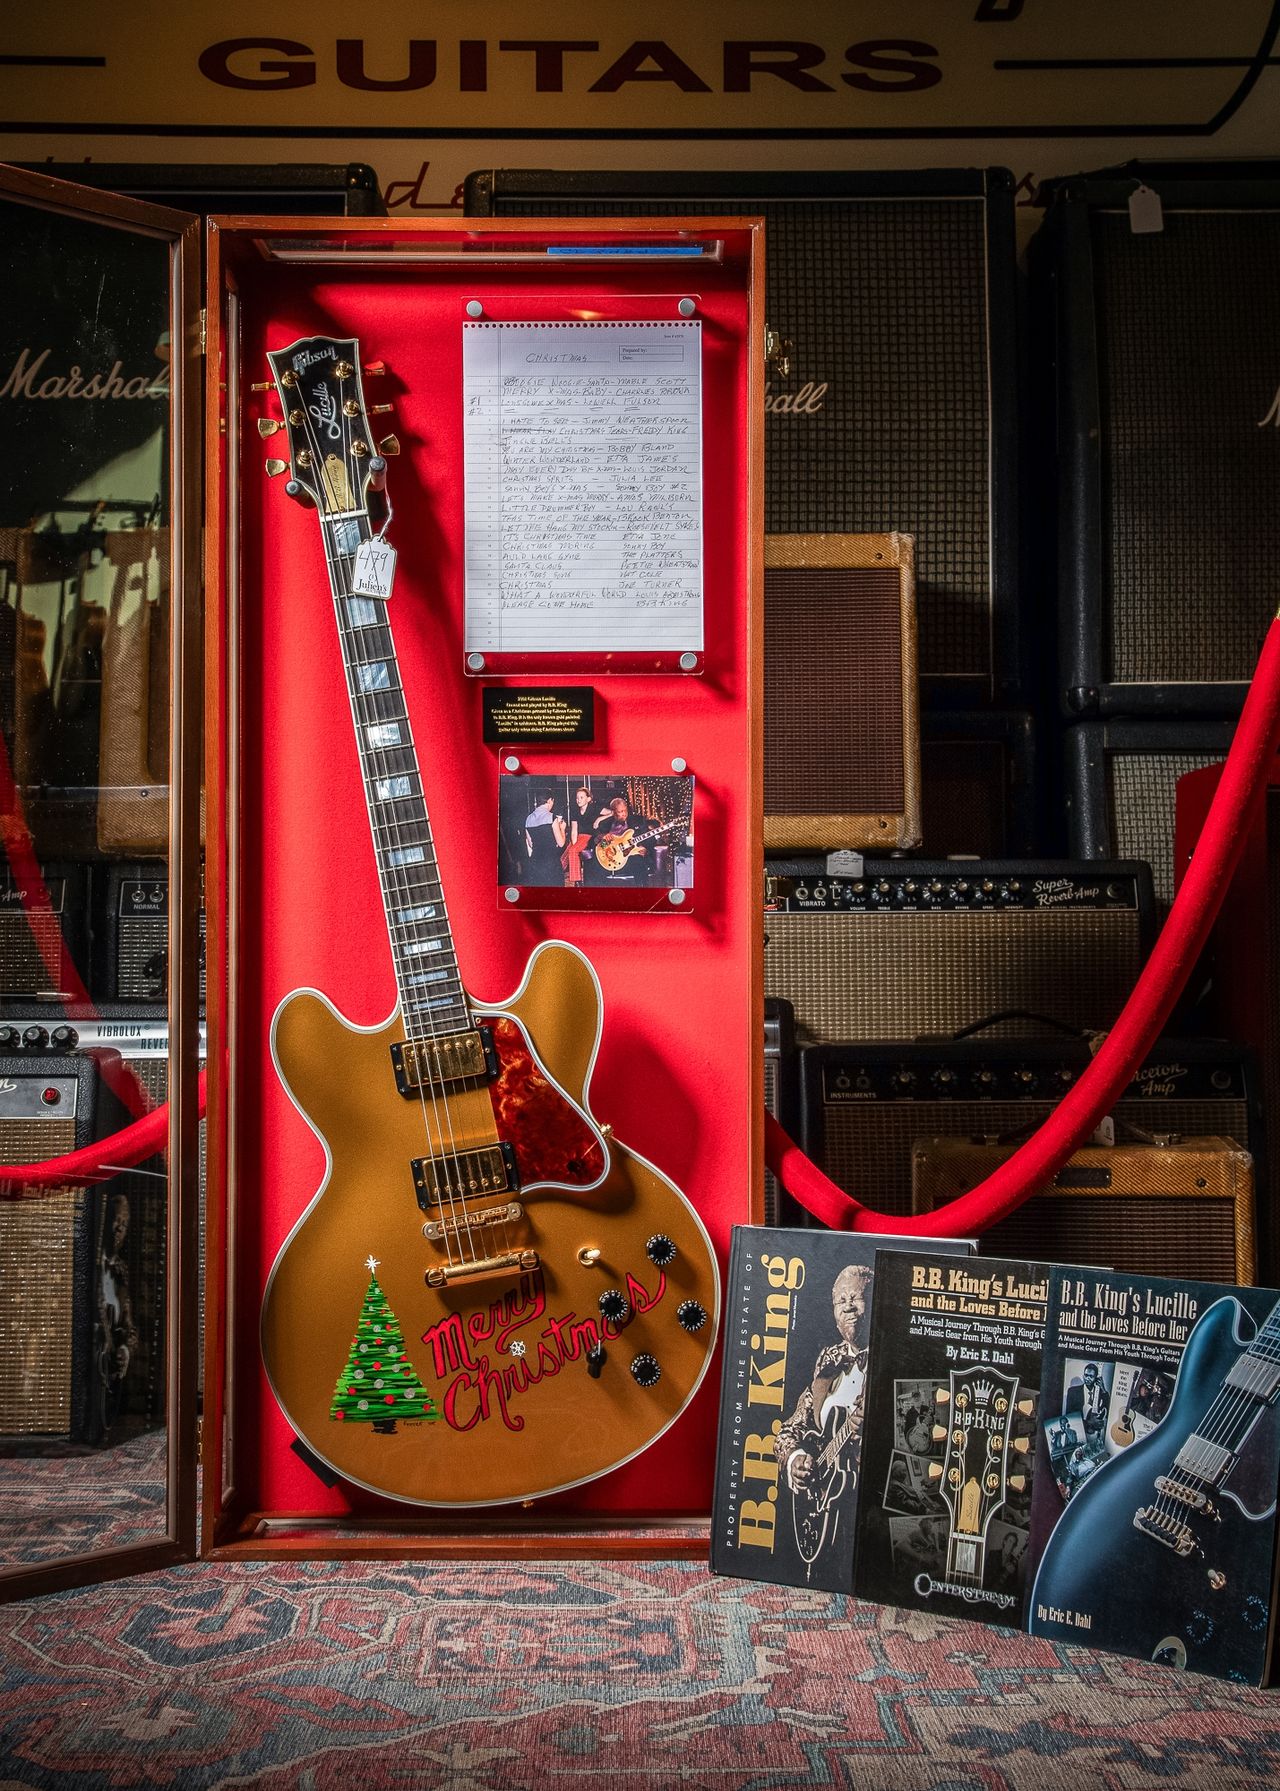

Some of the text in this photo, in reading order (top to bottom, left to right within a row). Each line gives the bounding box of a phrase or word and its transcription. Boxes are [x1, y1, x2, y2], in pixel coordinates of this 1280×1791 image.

[198, 37, 944, 93] GUITARS
[292, 345, 339, 376] Gibson
[525, 353, 587, 363] CHRISTMAS
[0, 348, 170, 399] Marshal
[309, 381, 341, 439] Lucille
[359, 550, 388, 572] 479
[356, 579, 387, 591] Julien's
[1032, 878, 1074, 893] Super
[97, 1025, 142, 1037] VIBROLUX
[912, 1266, 945, 1290] B.B.
[948, 1269, 1003, 1300] King's
[911, 1294, 1041, 1320] and the Loves Before
[1060, 1280, 1198, 1320] B.B. King's Lucille
[421, 1269, 546, 1380] Merry
[909, 1326, 1043, 1350] and Music Gear from His Youth through
[910, 1315, 1040, 1340] A Musical Journey Through B.B. King's
[1059, 1308, 1189, 1341] and the Loves Before Her
[443, 1272, 667, 1433] Christmas
[946, 1345, 1015, 1365] By Eric E. Dahl
[1064, 1335, 1085, 1344] Musical
[1085, 1337, 1108, 1348] Journey
[1108, 1340, 1131, 1351] Through
[1131, 1343, 1143, 1352] B.B.
[1143, 1345, 1160, 1355] King's
[1160, 1346, 1181, 1357] Guitars
[1069, 1343, 1085, 1351] Music
[1085, 1345, 1099, 1353] Gear
[1099, 1347, 1114, 1355] From
[1114, 1348, 1123, 1357] His
[1123, 1349, 1141, 1359] Youth
[1141, 1351, 1164, 1362] Through
[1164, 1354, 1181, 1365] Today
[726, 1253, 753, 1547] PROPERTY FROM THE ESTATE OF
[738, 1254, 806, 1555] B.B. King
[1037, 1603, 1092, 1630] By Eric E. Dahl
